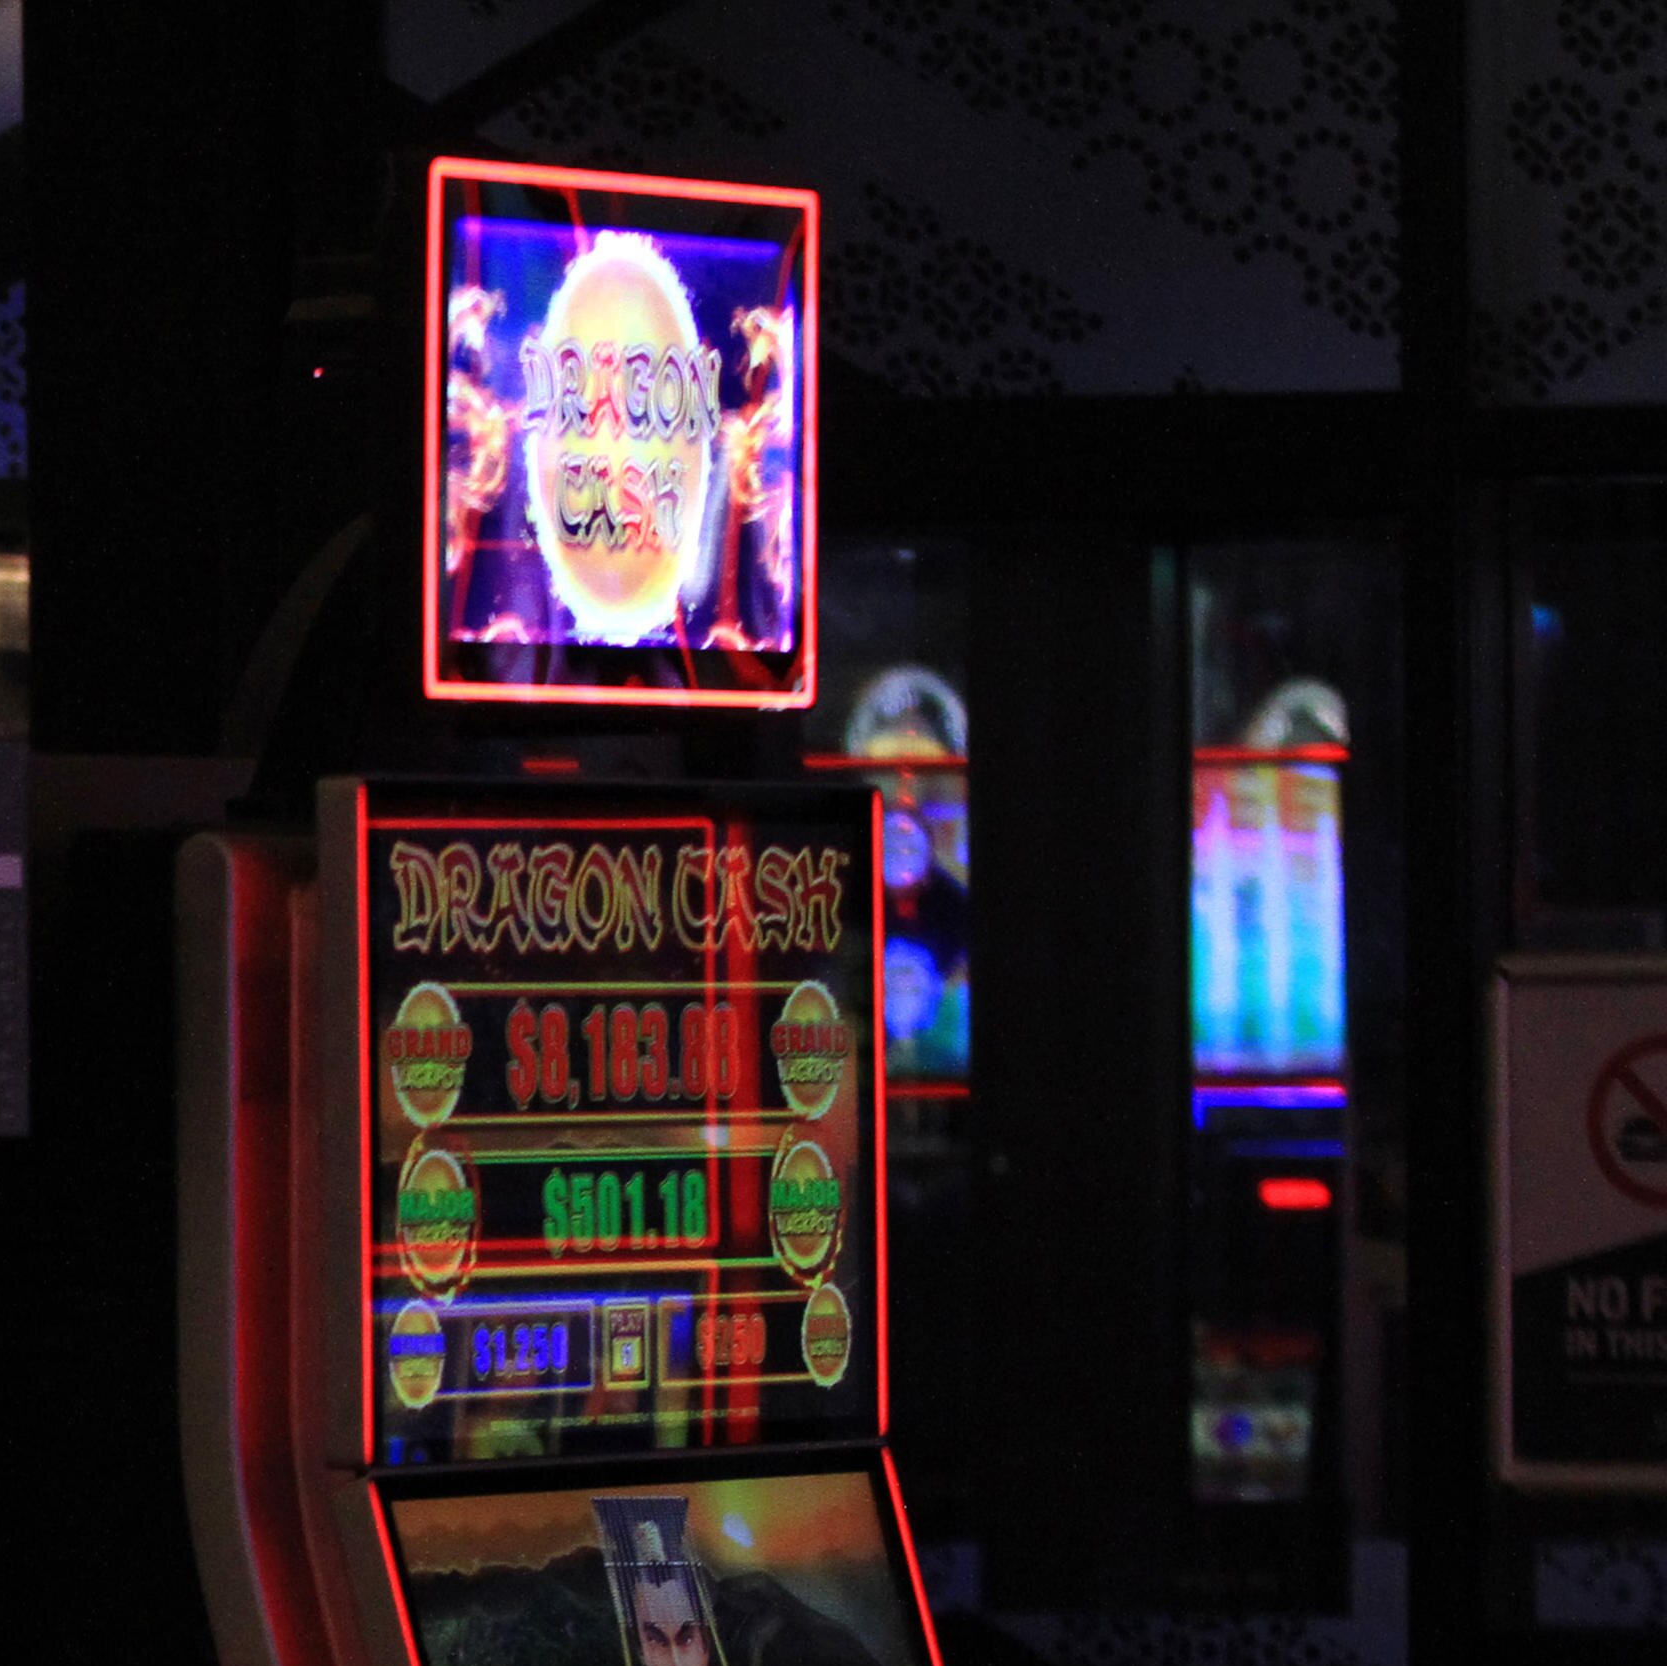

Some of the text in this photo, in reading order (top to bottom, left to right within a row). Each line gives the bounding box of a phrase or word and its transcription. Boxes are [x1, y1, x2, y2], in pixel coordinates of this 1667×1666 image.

[519, 335, 722, 439] DRAGON
[553, 450, 684, 552] CASH
[389, 840, 843, 954] DRAGON CASH
[387, 1023, 473, 1061] GRAND
[506, 998, 739, 1111] $8,183.88
[770, 1020, 850, 1058] GRAND
[398, 1187, 476, 1223] MAJOR
[543, 1167, 707, 1258] $501.18
[770, 1178, 840, 1209] MAJOR
[1567, 1276, 1629, 1320] NO
